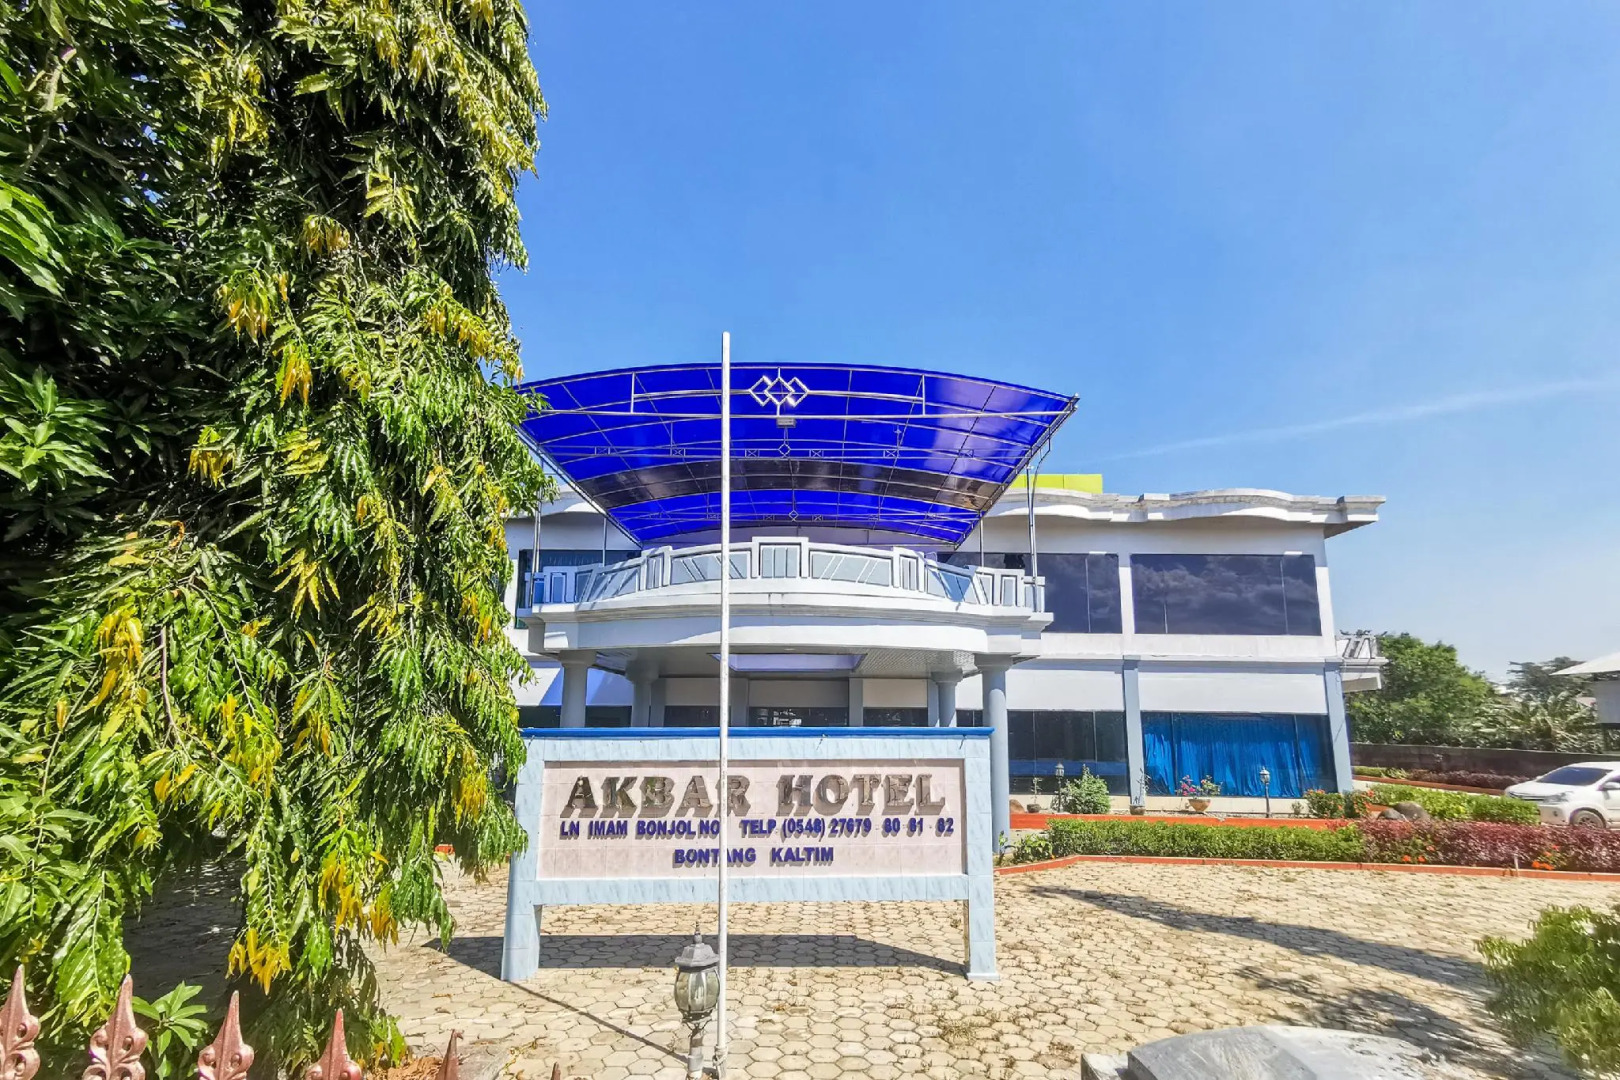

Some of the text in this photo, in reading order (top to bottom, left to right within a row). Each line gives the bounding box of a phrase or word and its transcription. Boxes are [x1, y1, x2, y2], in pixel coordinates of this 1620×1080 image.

[560, 774, 946, 818] AKBAR HOTEL
[560, 820, 580, 837] LN
[589, 820, 628, 837] IMAM
[636, 819, 697, 837] BONJOL
[771, 847, 834, 864] KALTIM
